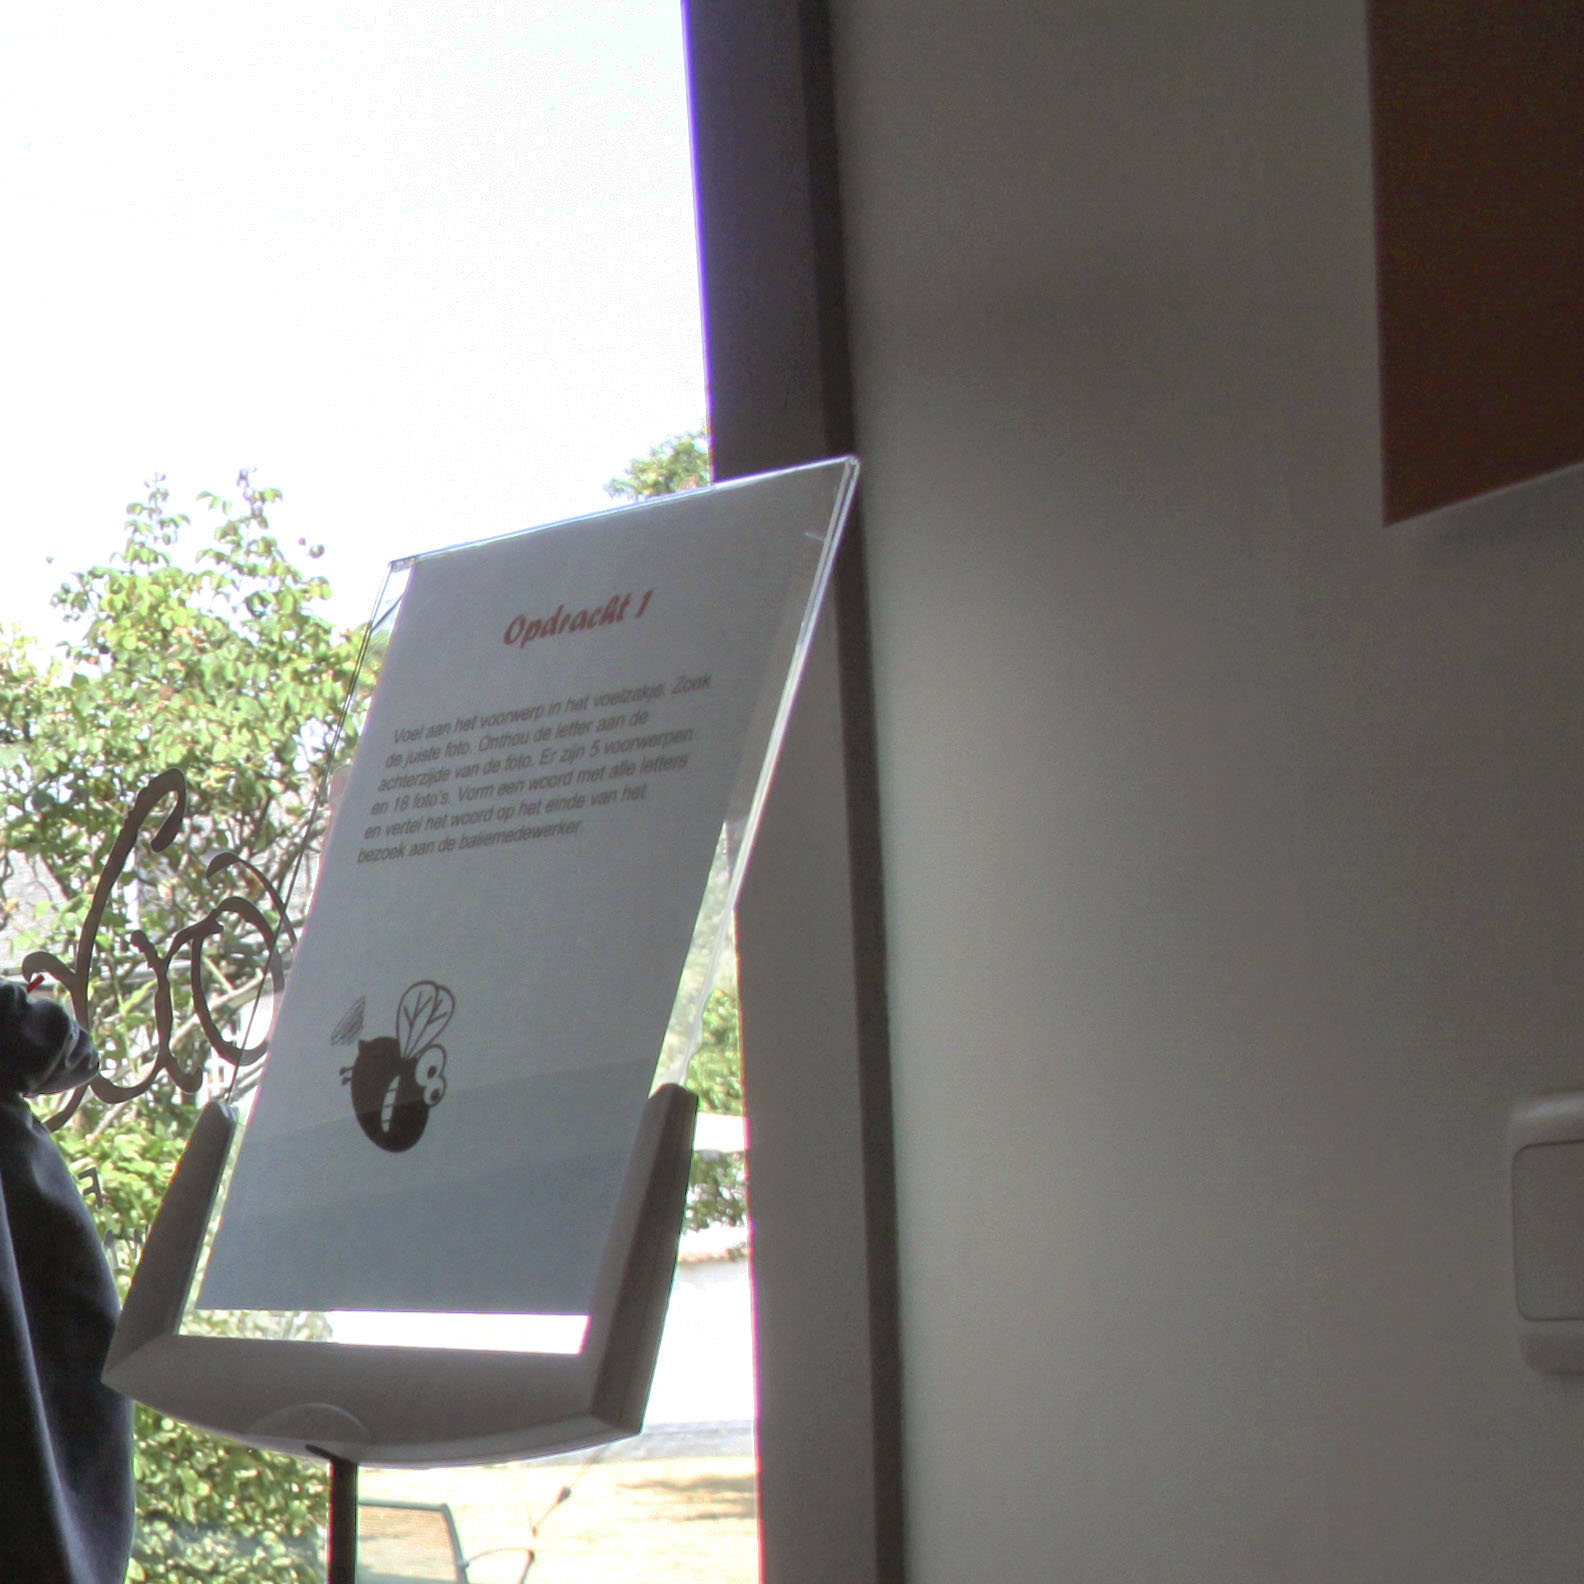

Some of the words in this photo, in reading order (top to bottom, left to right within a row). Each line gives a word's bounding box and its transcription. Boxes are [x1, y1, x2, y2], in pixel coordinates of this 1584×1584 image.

[503, 592, 632, 648] Opdracht
[385, 753, 402, 768] de
[403, 746, 441, 769] juiste
[479, 731, 530, 752] Onthou
[533, 725, 552, 743] de
[555, 718, 593, 739] letter
[596, 714, 625, 732] aan
[629, 709, 649, 727] de
[394, 725, 424, 745] Voel
[426, 722, 451, 739] aan
[455, 715, 477, 733] het
[481, 704, 545, 728] voorwerp
[548, 701, 561, 716] in
[565, 695, 589, 713] het
[671, 674, 712, 695] Zoek
[370, 801, 388, 816] en
[394, 795, 409, 812] 18
[458, 782, 495, 801] Vorm
[497, 780, 524, 797] een
[528, 770, 573, 792] woord
[576, 765, 606, 784] met
[608, 759, 636, 779] alle
[640, 752, 689, 774] letters
[377, 767, 451, 792] achterzijde
[455, 763, 480, 779] van
[482, 759, 501, 775] de
[539, 748, 557, 766] Er
[559, 743, 585, 765] zijn
[589, 739, 601, 758] 5
[604, 727, 695, 755] voorwerpen
[363, 825, 381, 840] en
[385, 817, 421, 837] vertel
[425, 814, 447, 831] het
[450, 805, 494, 827] woord
[496, 805, 515, 823] op
[519, 800, 542, 817] het
[545, 794, 586, 813] einde
[591, 789, 618, 806] van
[622, 782, 647, 801] het
[357, 845, 405, 864] bezoek
[409, 841, 435, 858] aan
[438, 836, 456, 853] de
